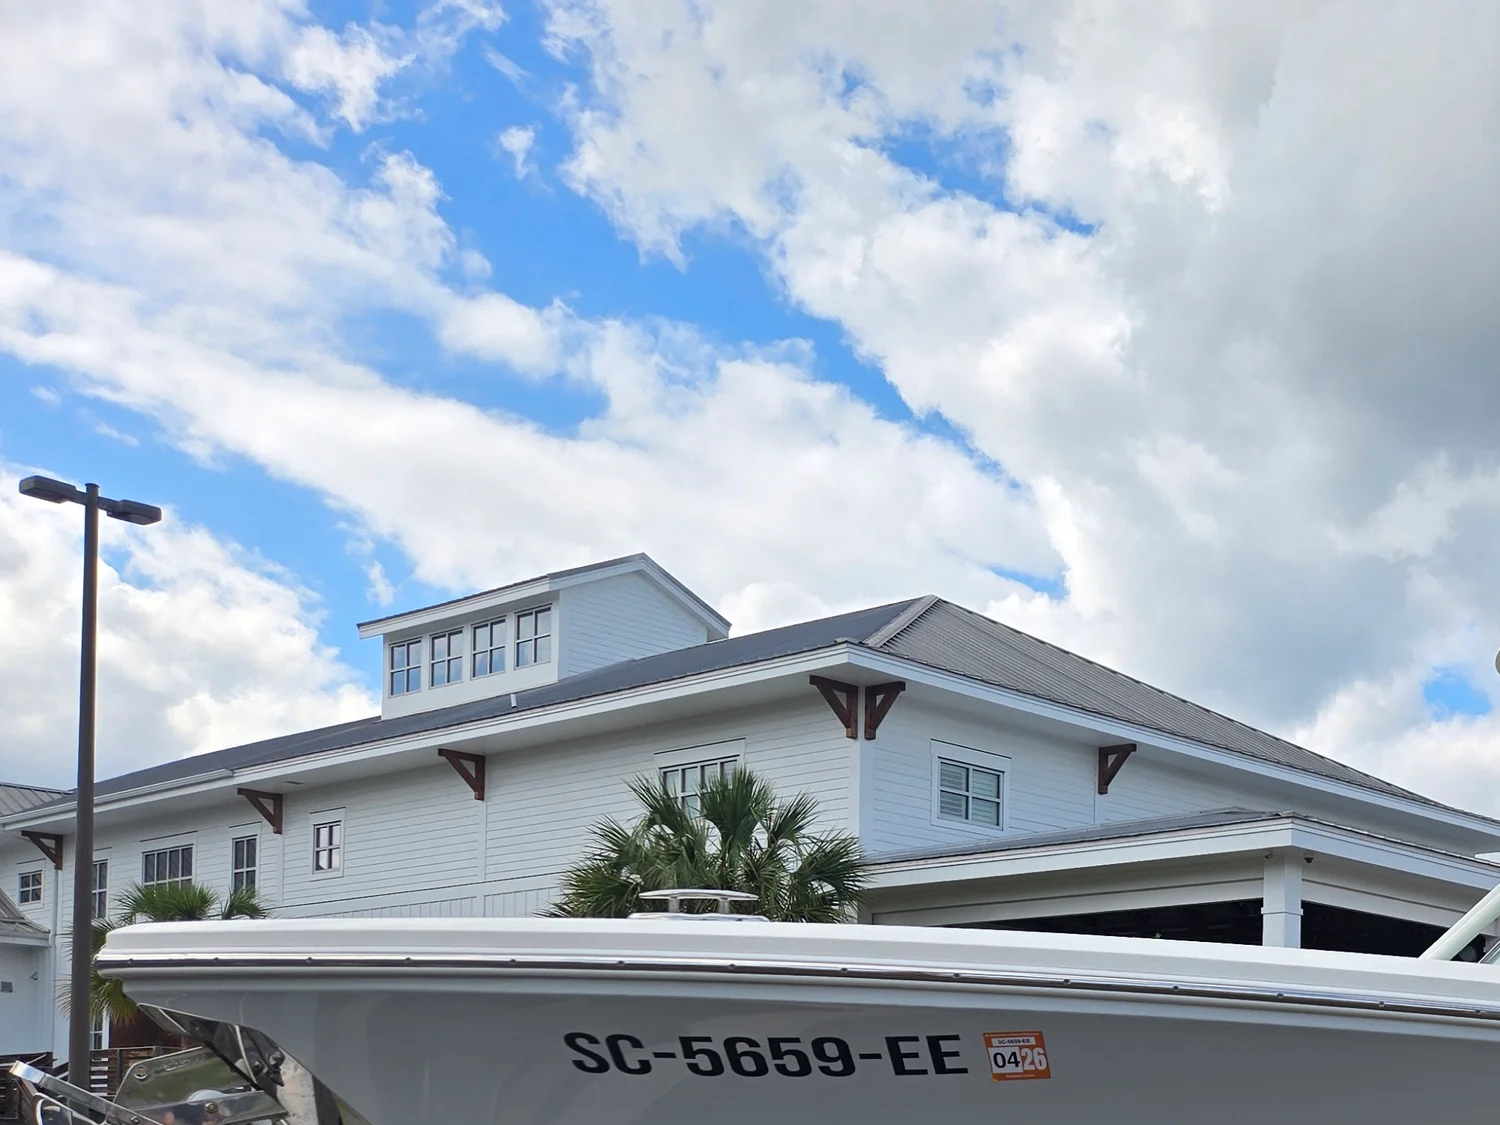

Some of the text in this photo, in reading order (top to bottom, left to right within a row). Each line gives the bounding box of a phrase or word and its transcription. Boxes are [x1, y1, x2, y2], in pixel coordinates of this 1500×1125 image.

[563, 1031, 969, 1078] SC-5659-EE
[993, 1047, 1047, 1070] 04 26
